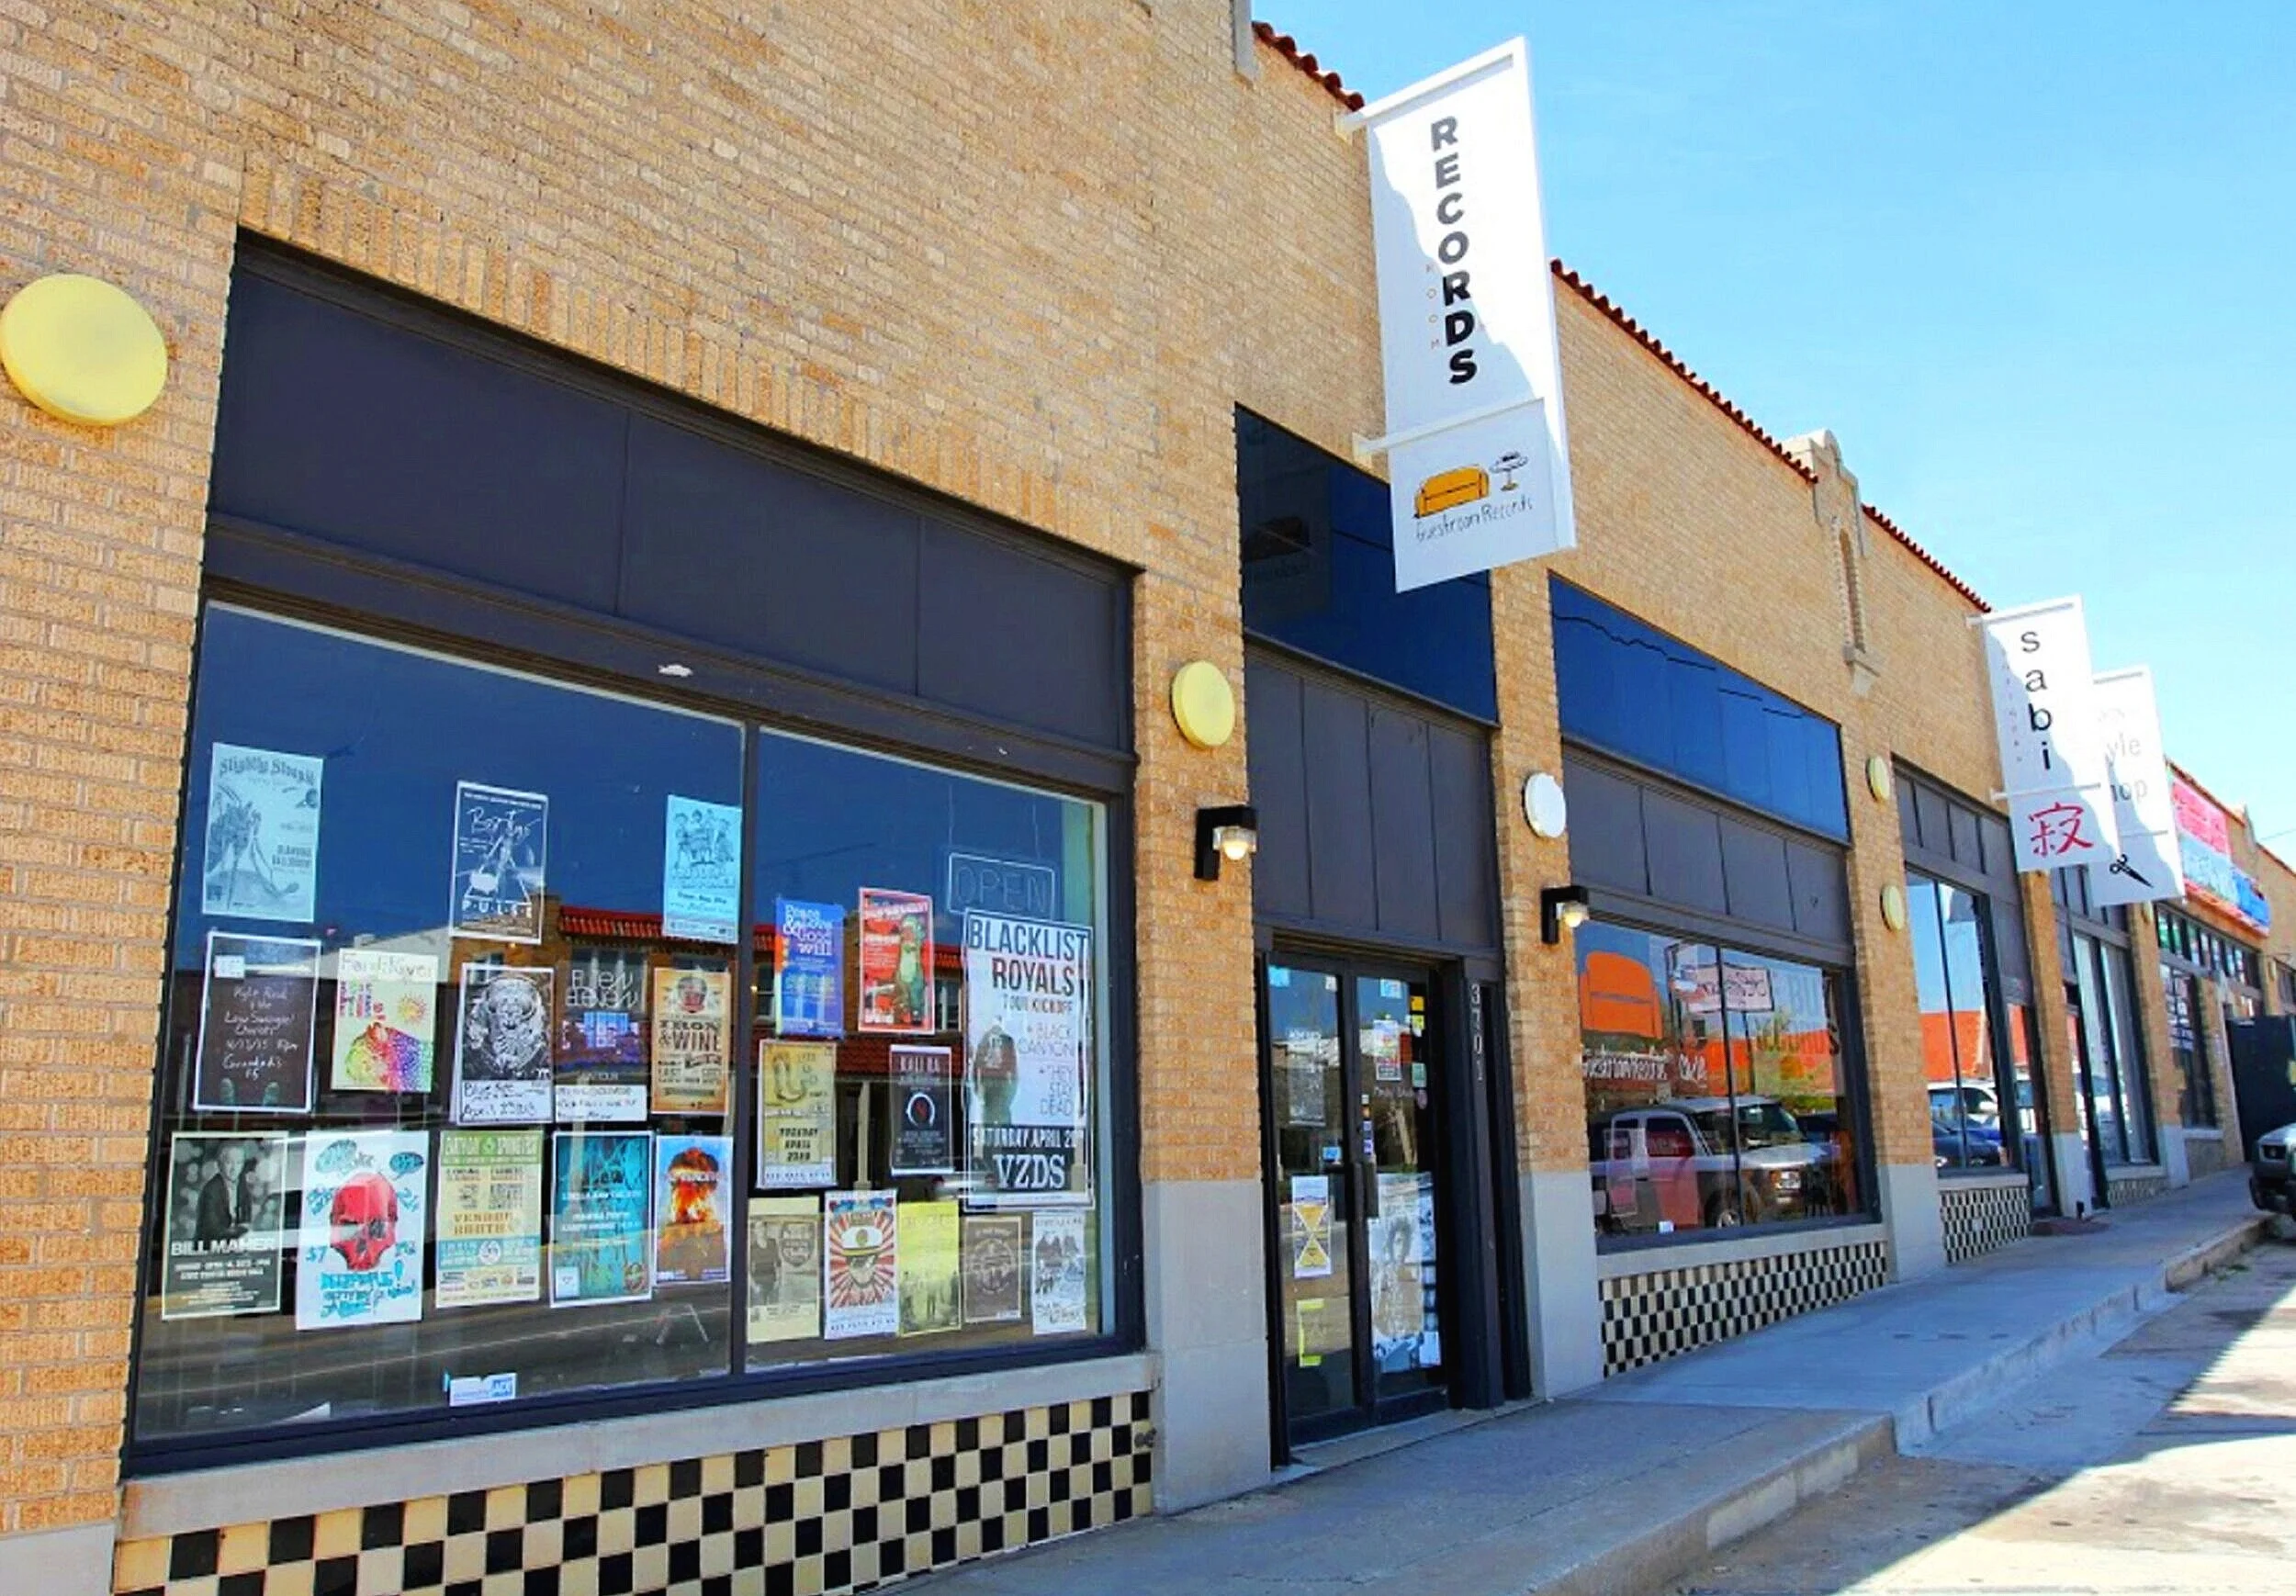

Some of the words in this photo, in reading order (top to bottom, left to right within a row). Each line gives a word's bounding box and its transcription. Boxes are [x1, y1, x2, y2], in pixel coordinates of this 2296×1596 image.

[1430, 115, 1478, 385] RECORDS
[2020, 630, 2053, 770] sabi
[2028, 802, 2095, 857] 寂
[954, 863, 1047, 914] OPEN
[968, 917, 1087, 963] BLACKLIST
[992, 957, 1075, 996] ROYALS
[993, 1153, 1065, 1189] VZDS
[171, 1240, 208, 1256] BILL
